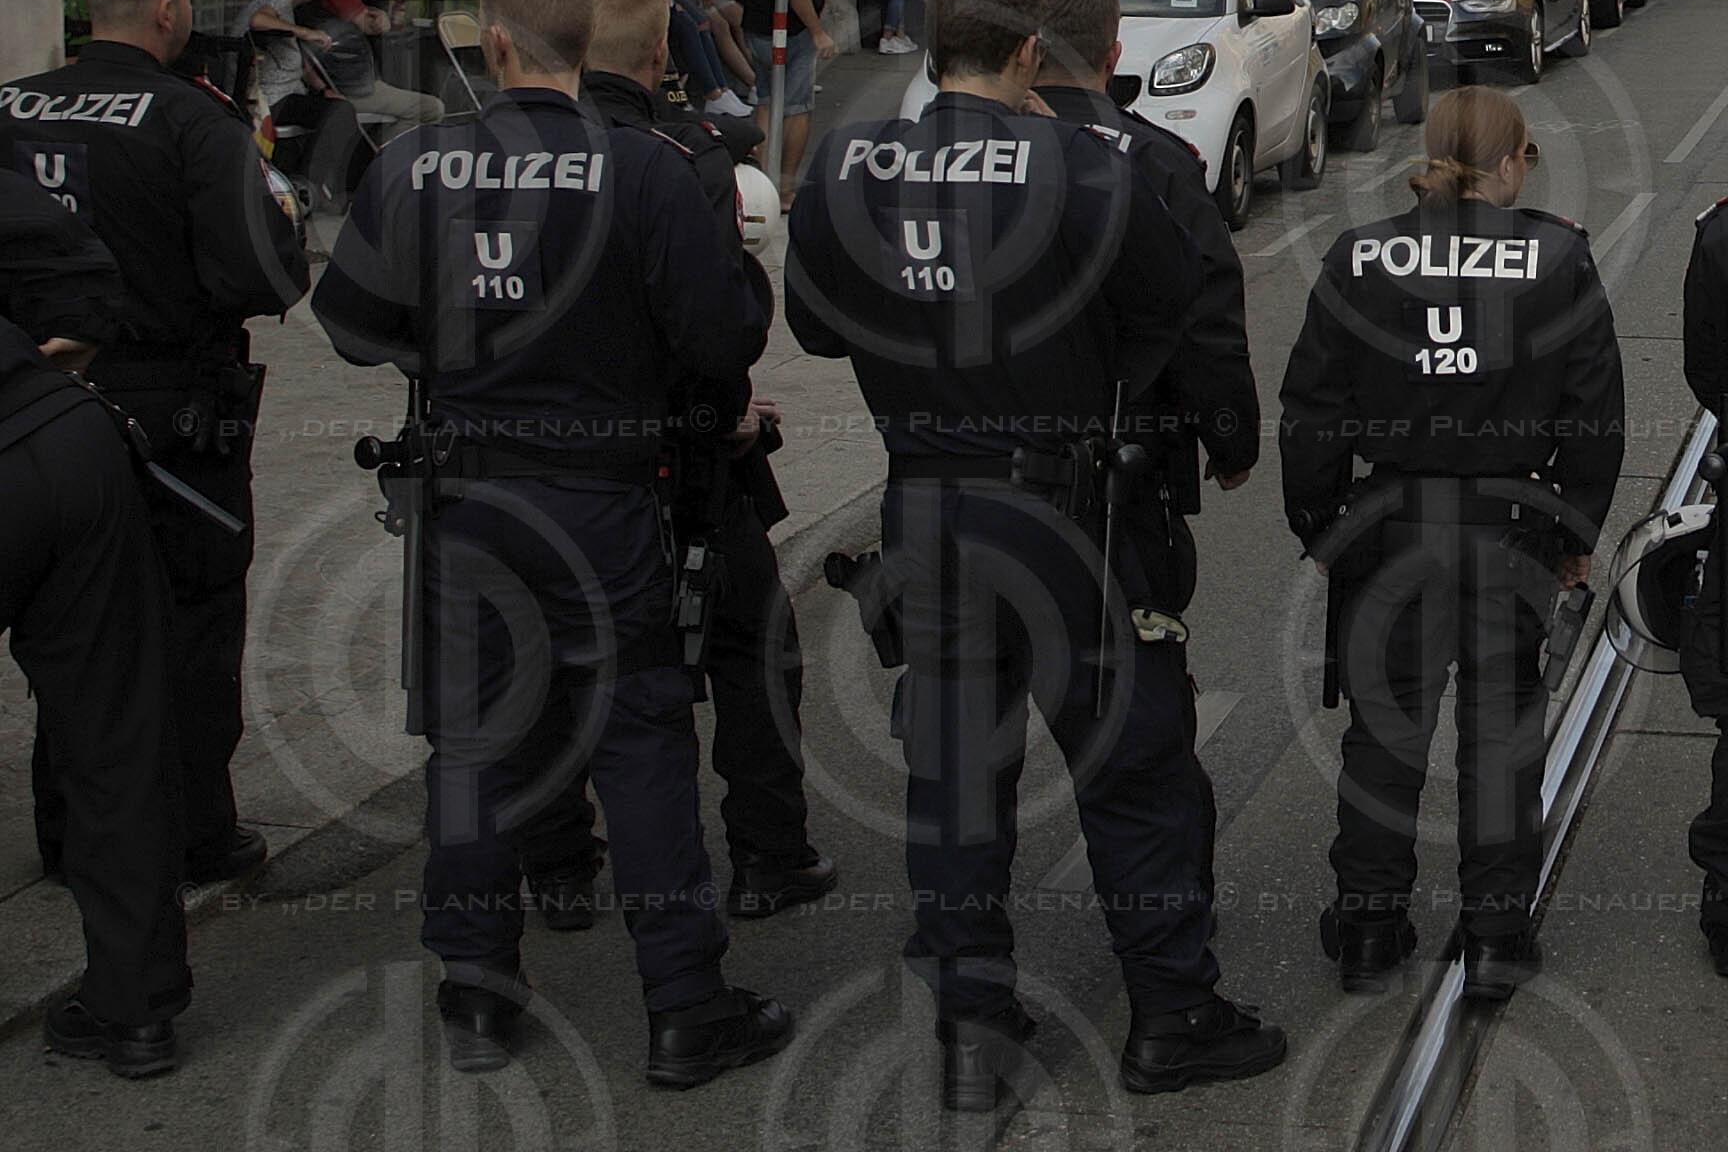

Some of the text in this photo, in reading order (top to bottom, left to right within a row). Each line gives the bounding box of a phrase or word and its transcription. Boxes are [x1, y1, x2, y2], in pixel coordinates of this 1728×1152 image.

[34, 152, 66, 189] U
[411, 149, 604, 192] POLIZEI
[838, 139, 1032, 184] POLIZEI
[474, 232, 513, 270] U
[903, 219, 943, 261] U
[1351, 234, 1540, 280] POLIZEI
[472, 273, 525, 301] 110
[900, 265, 956, 293] 110
[1426, 306, 1463, 344] U
[1414, 347, 1479, 375] 120
